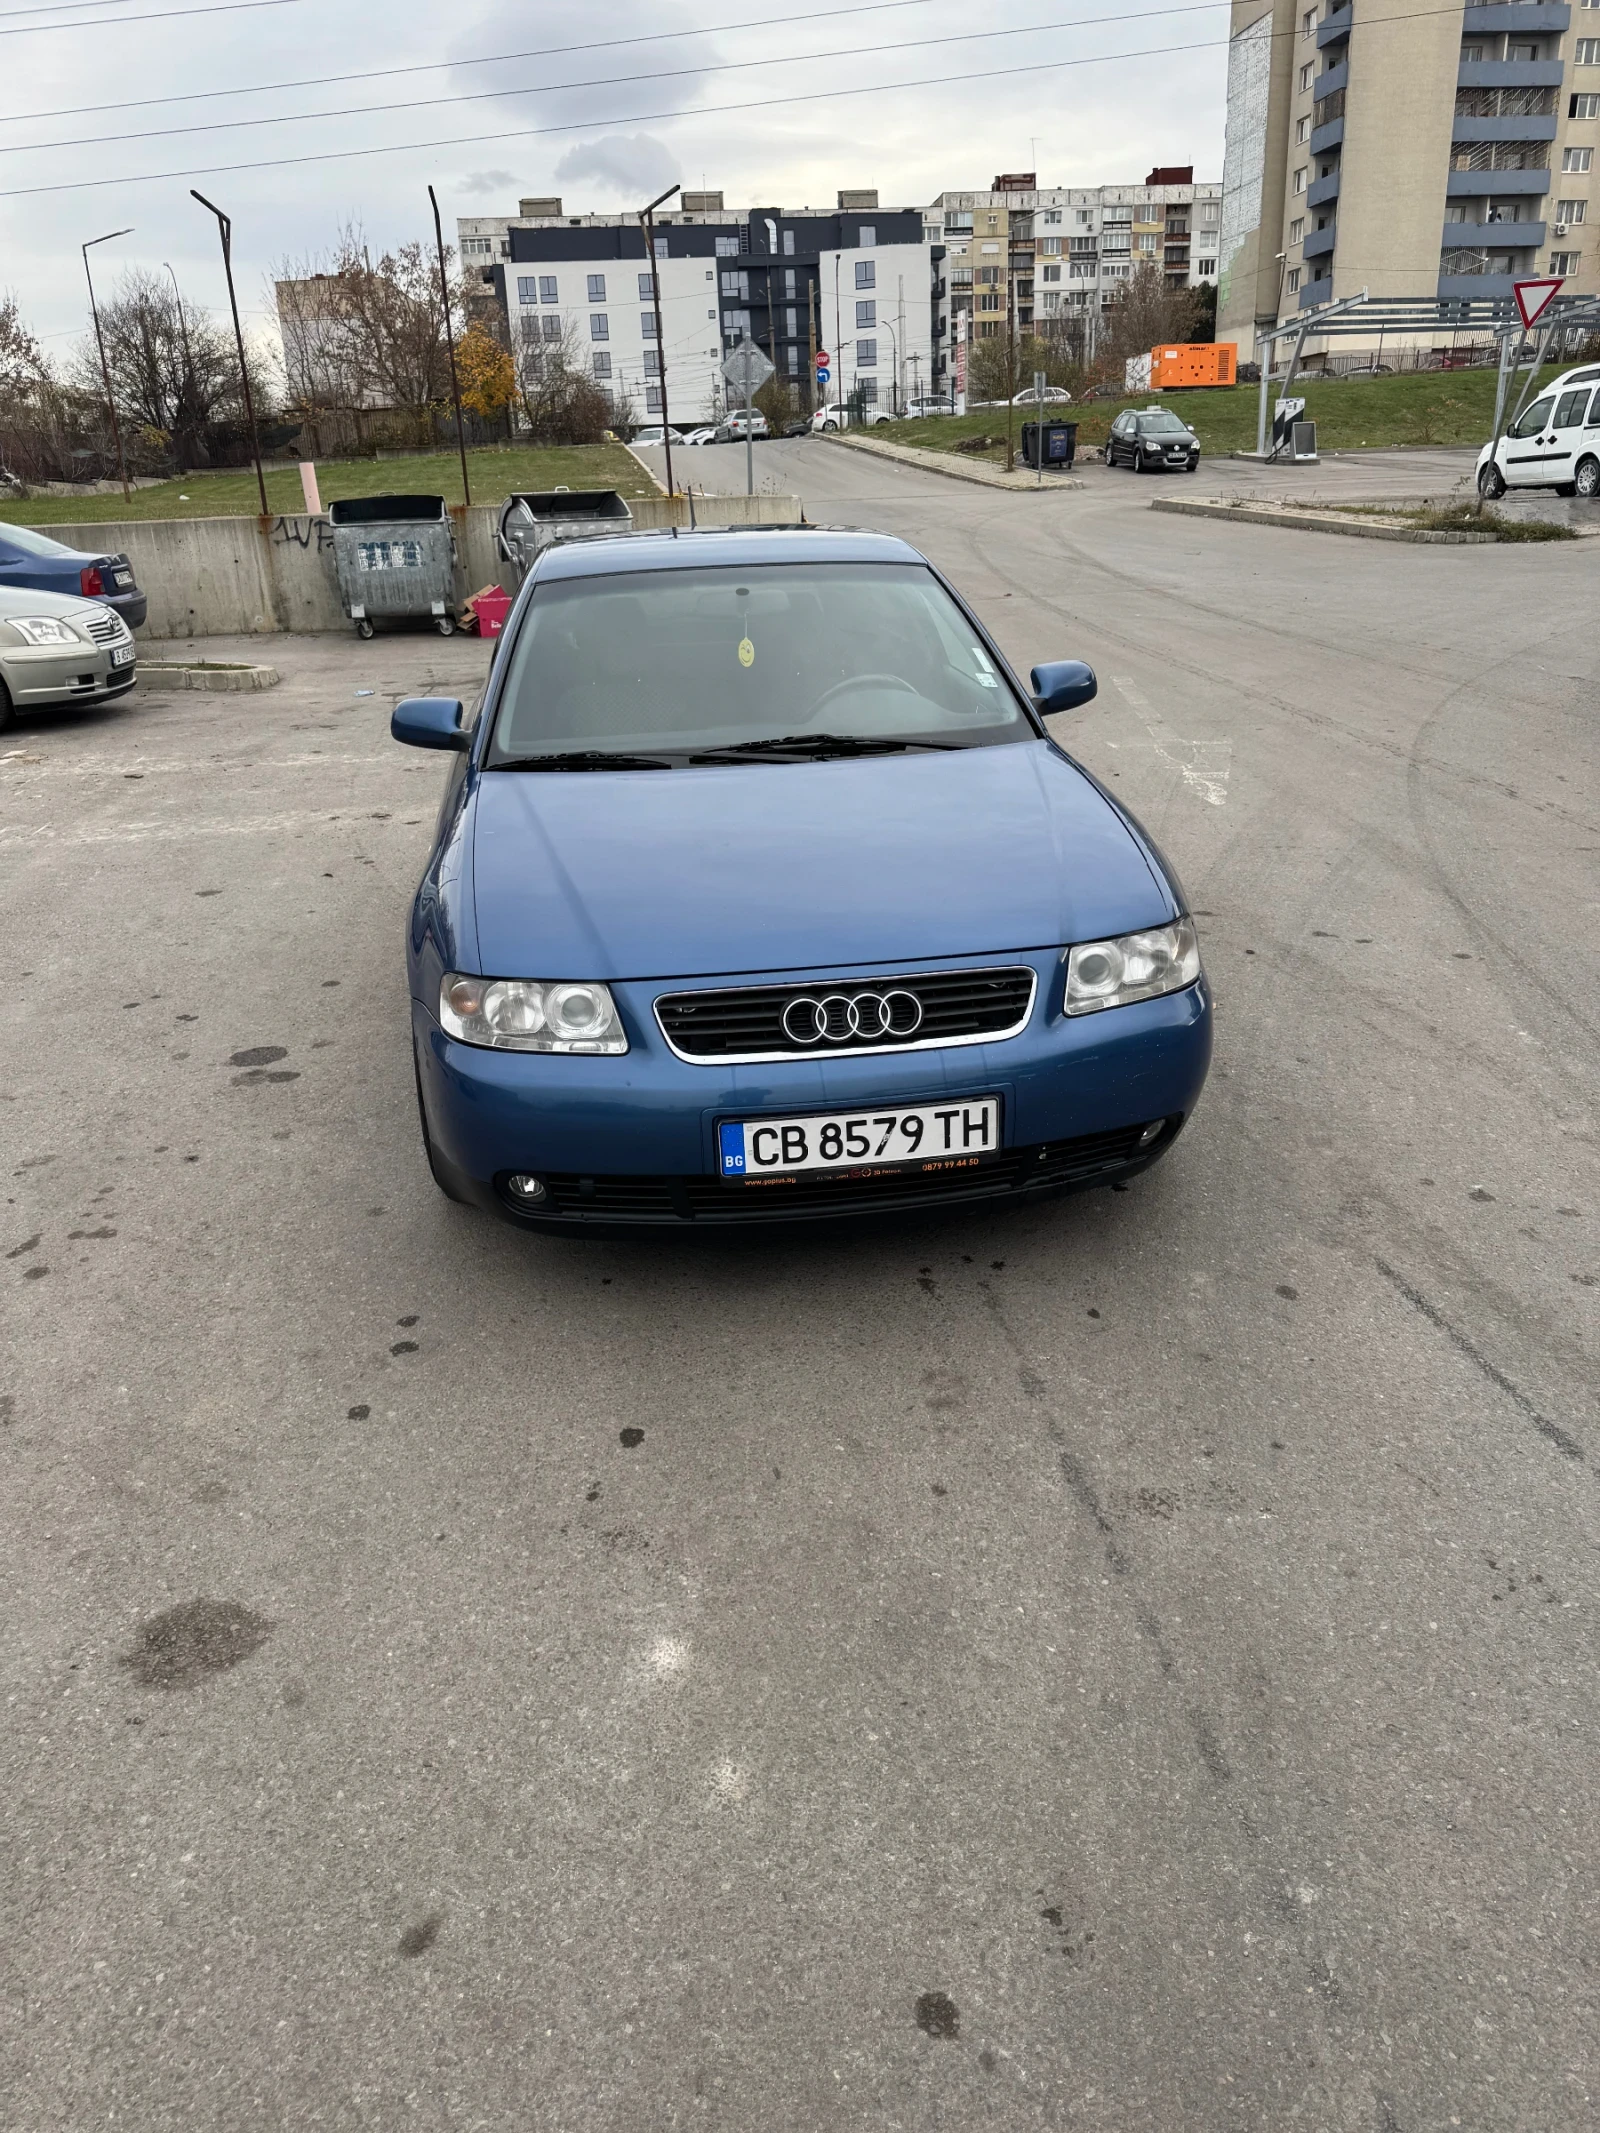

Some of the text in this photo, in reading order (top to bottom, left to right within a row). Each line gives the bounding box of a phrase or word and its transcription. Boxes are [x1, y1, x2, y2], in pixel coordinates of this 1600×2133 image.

[816, 355, 829, 363] STOP
[752, 1106, 989, 1166] CB 8579 TH
[725, 1155, 743, 1168] BG
[922, 1157, 979, 1172] 0879 99 44 50
